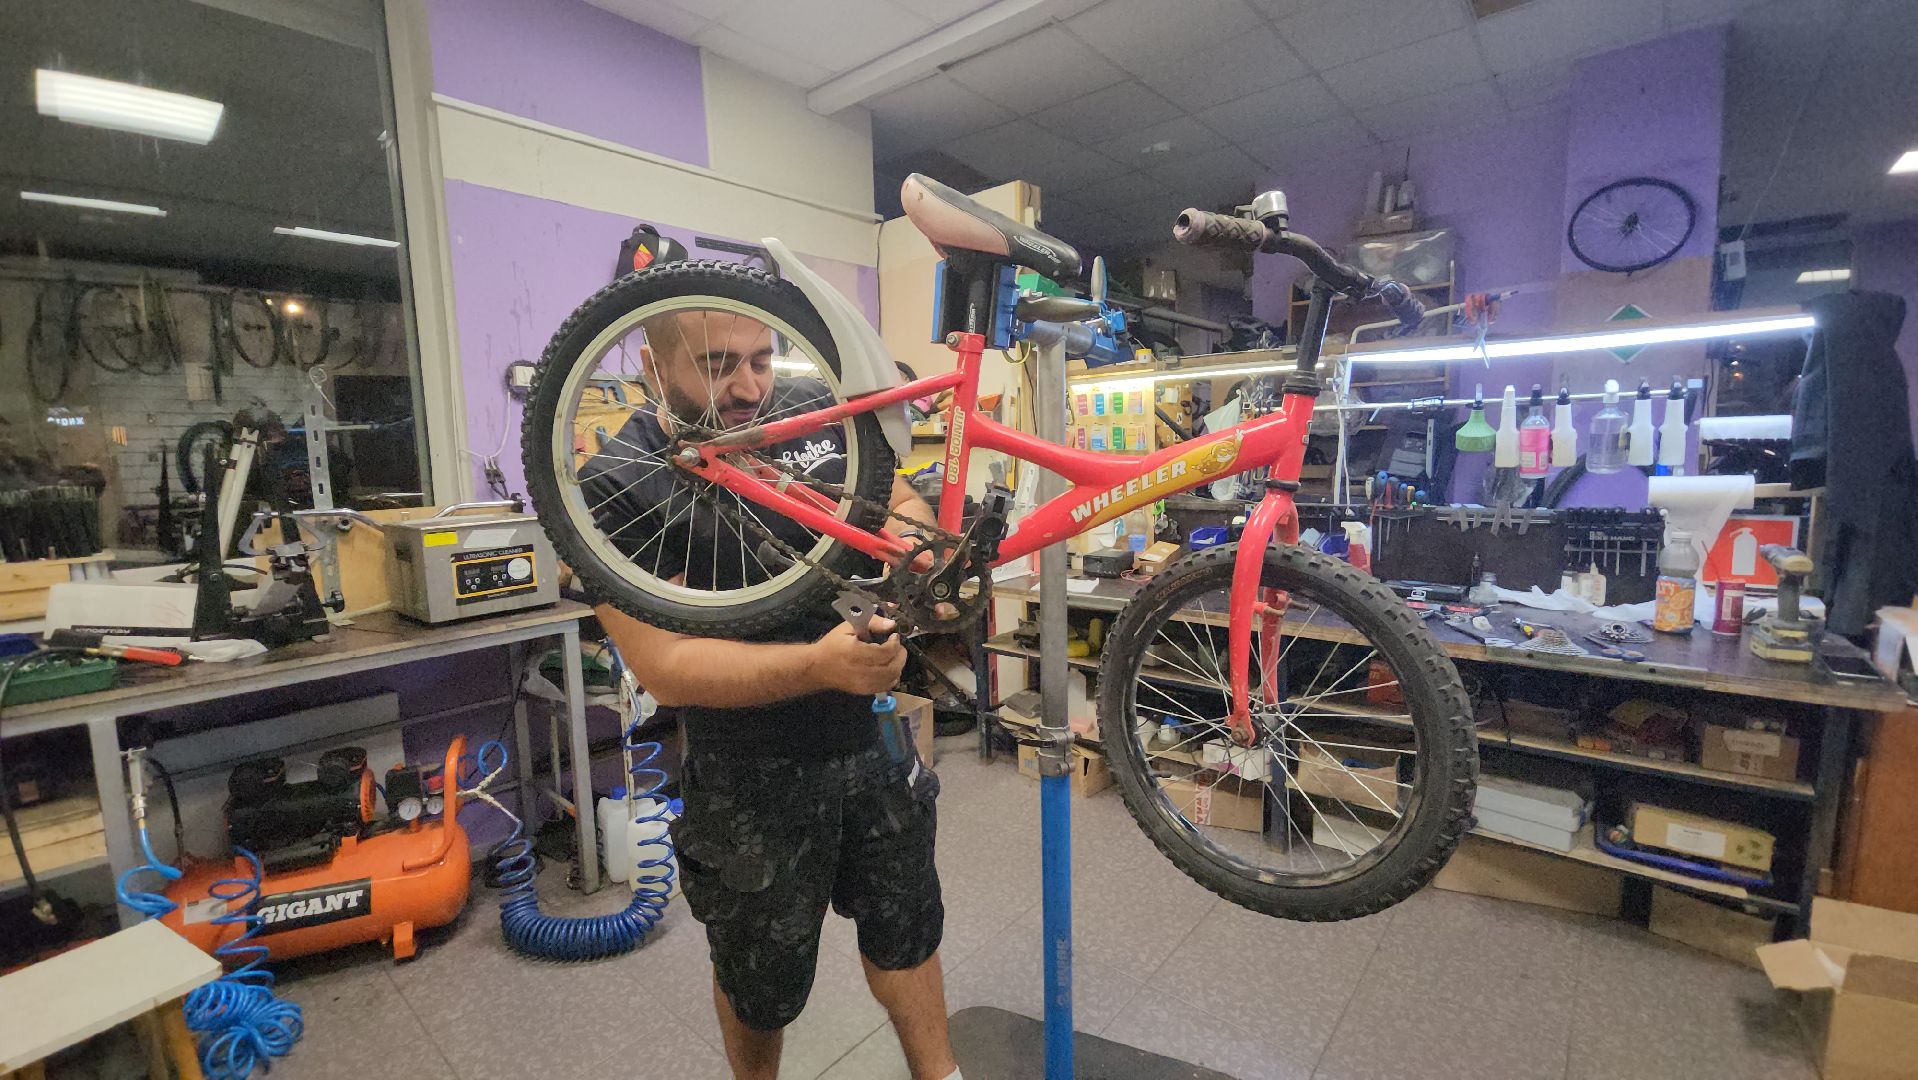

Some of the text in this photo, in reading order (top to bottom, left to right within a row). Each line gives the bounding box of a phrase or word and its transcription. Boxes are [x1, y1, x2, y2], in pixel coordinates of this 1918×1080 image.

[947, 406, 965, 484] JUNIOR 180
[1070, 460, 1188, 524] WHEELER
[463, 547, 523, 560] ULTRASONIC CLEANER
[256, 889, 364, 925] GIGANT
